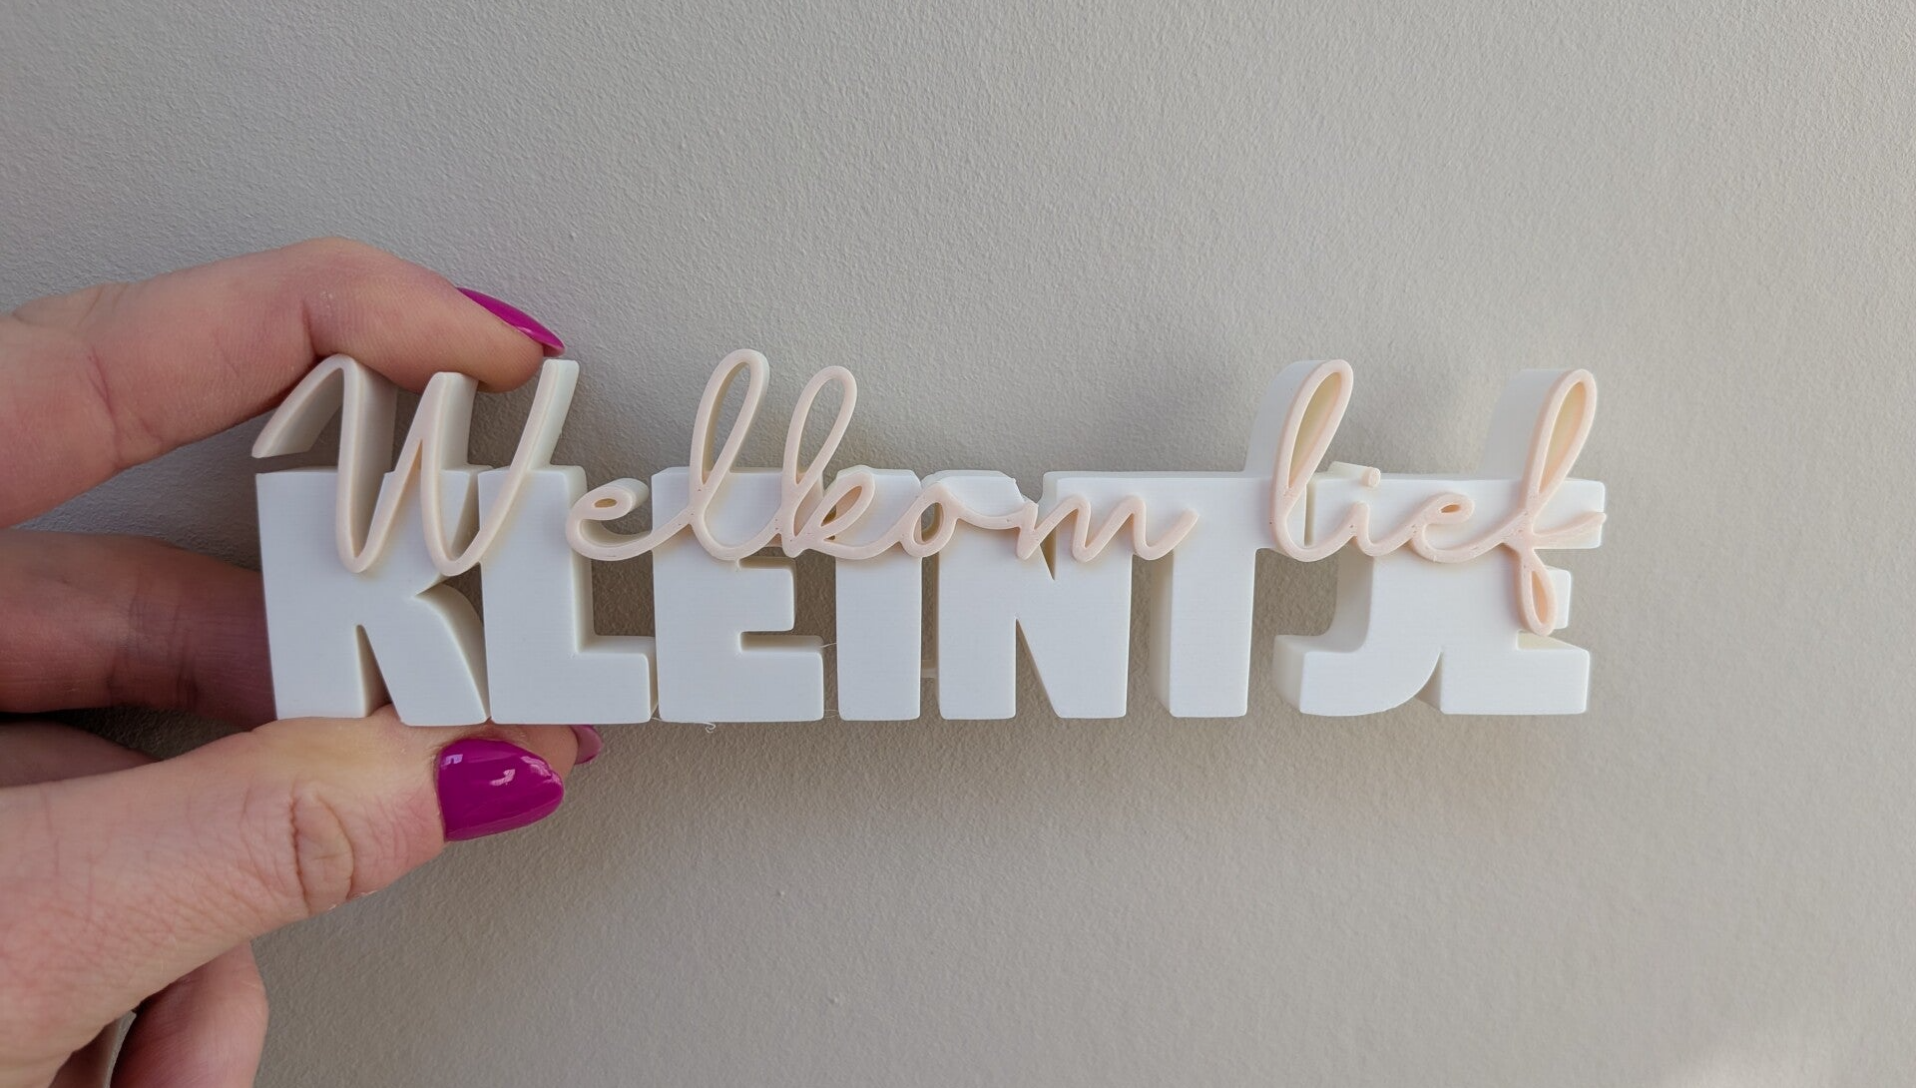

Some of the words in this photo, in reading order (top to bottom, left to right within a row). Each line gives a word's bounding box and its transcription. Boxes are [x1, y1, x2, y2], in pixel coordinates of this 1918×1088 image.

[251, 349, 1199, 577] Welkom
[1268, 359, 1607, 636] lief
[255, 464, 1606, 727] KLEINTJE
